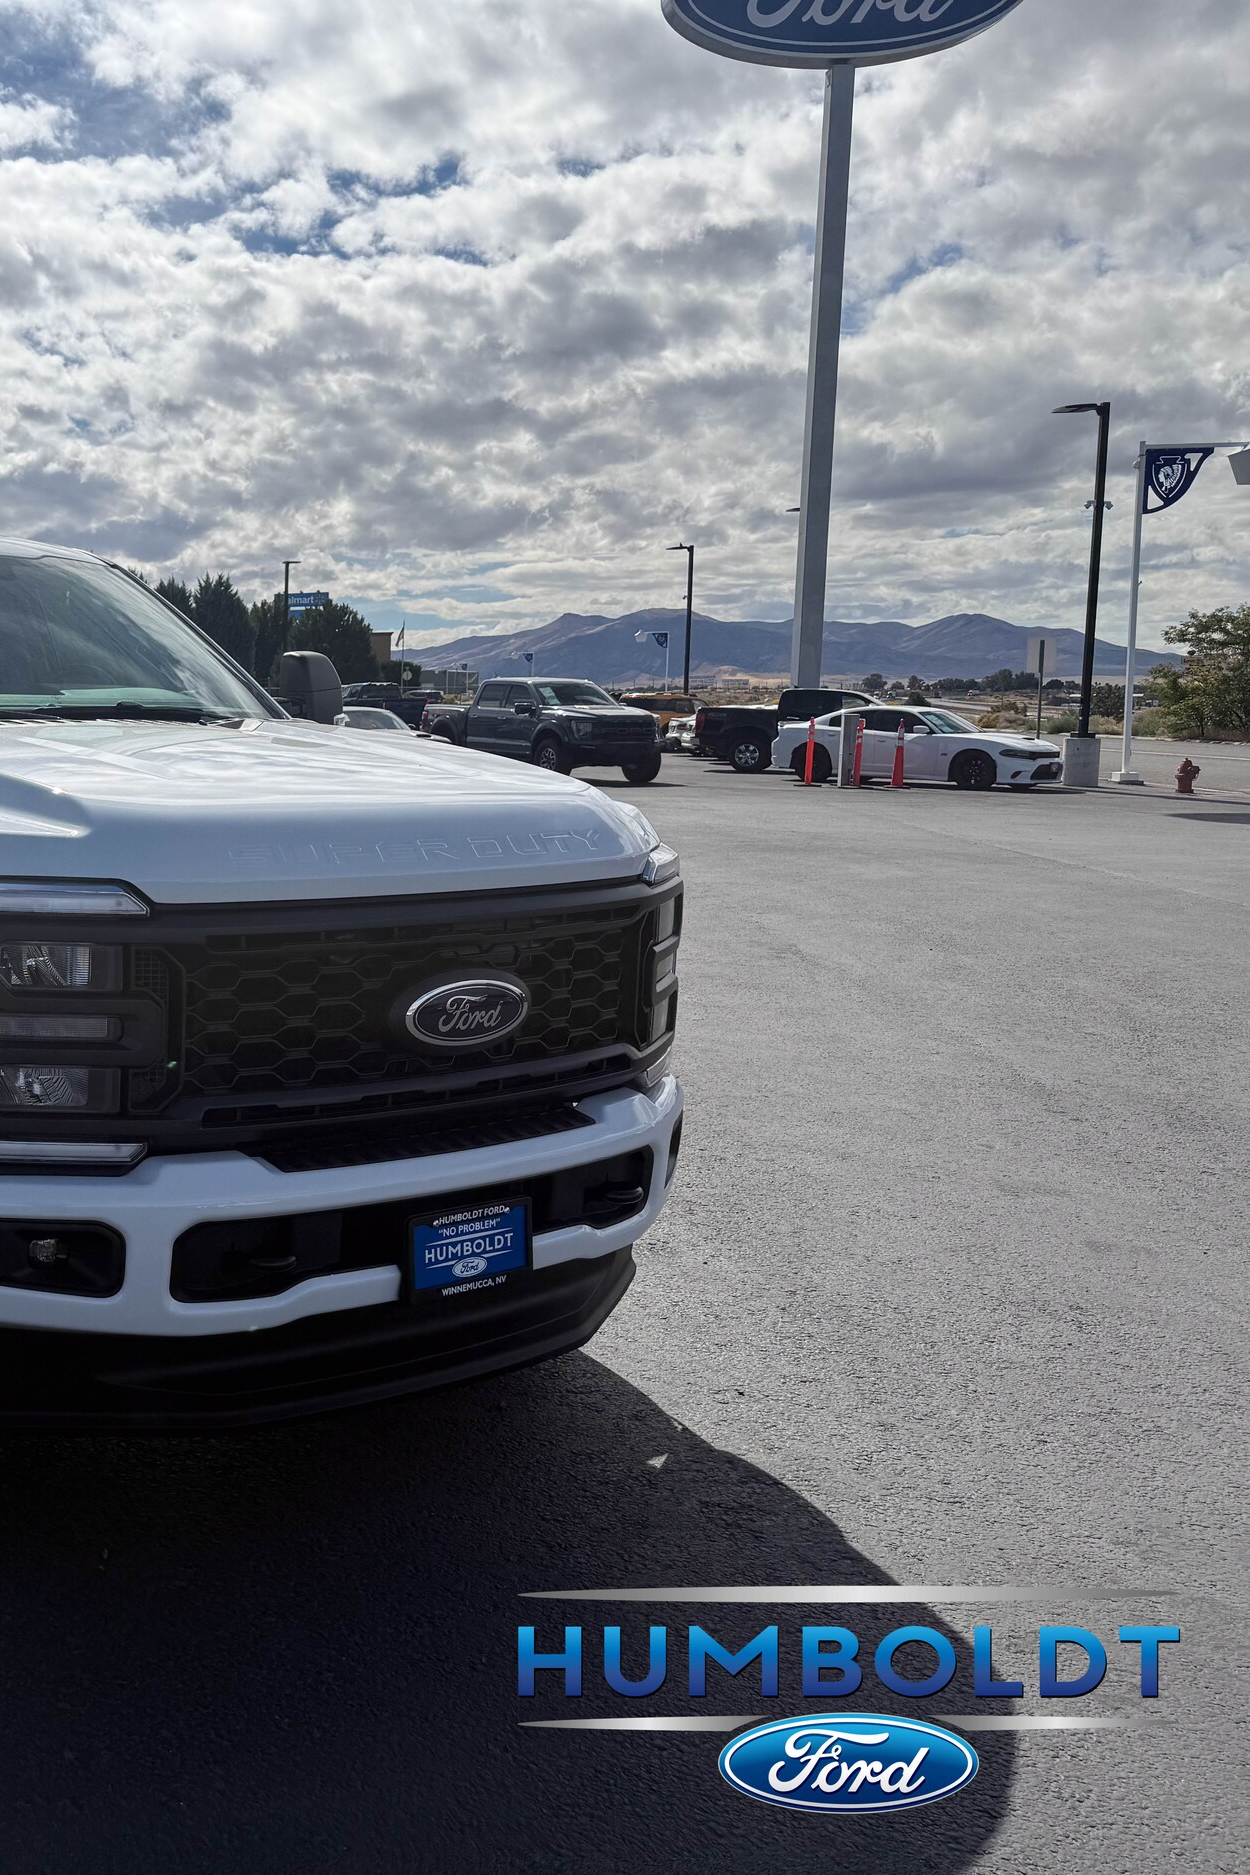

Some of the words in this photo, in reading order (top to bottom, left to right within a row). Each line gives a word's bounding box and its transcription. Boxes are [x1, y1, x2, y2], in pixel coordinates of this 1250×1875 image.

[287, 595, 314, 605] almart
[228, 838, 462, 867] SUPER
[466, 829, 600, 858] DUTY
[438, 995, 504, 1033] Ford
[439, 1209, 484, 1225] HUMBOLDT
[484, 1205, 505, 1216] FORD
[425, 1233, 514, 1264] HUMBOLDT
[460, 1260, 480, 1274] Ford
[441, 1278, 495, 1296] WINNEMUCCA,
[495, 1275, 507, 1284] NV
